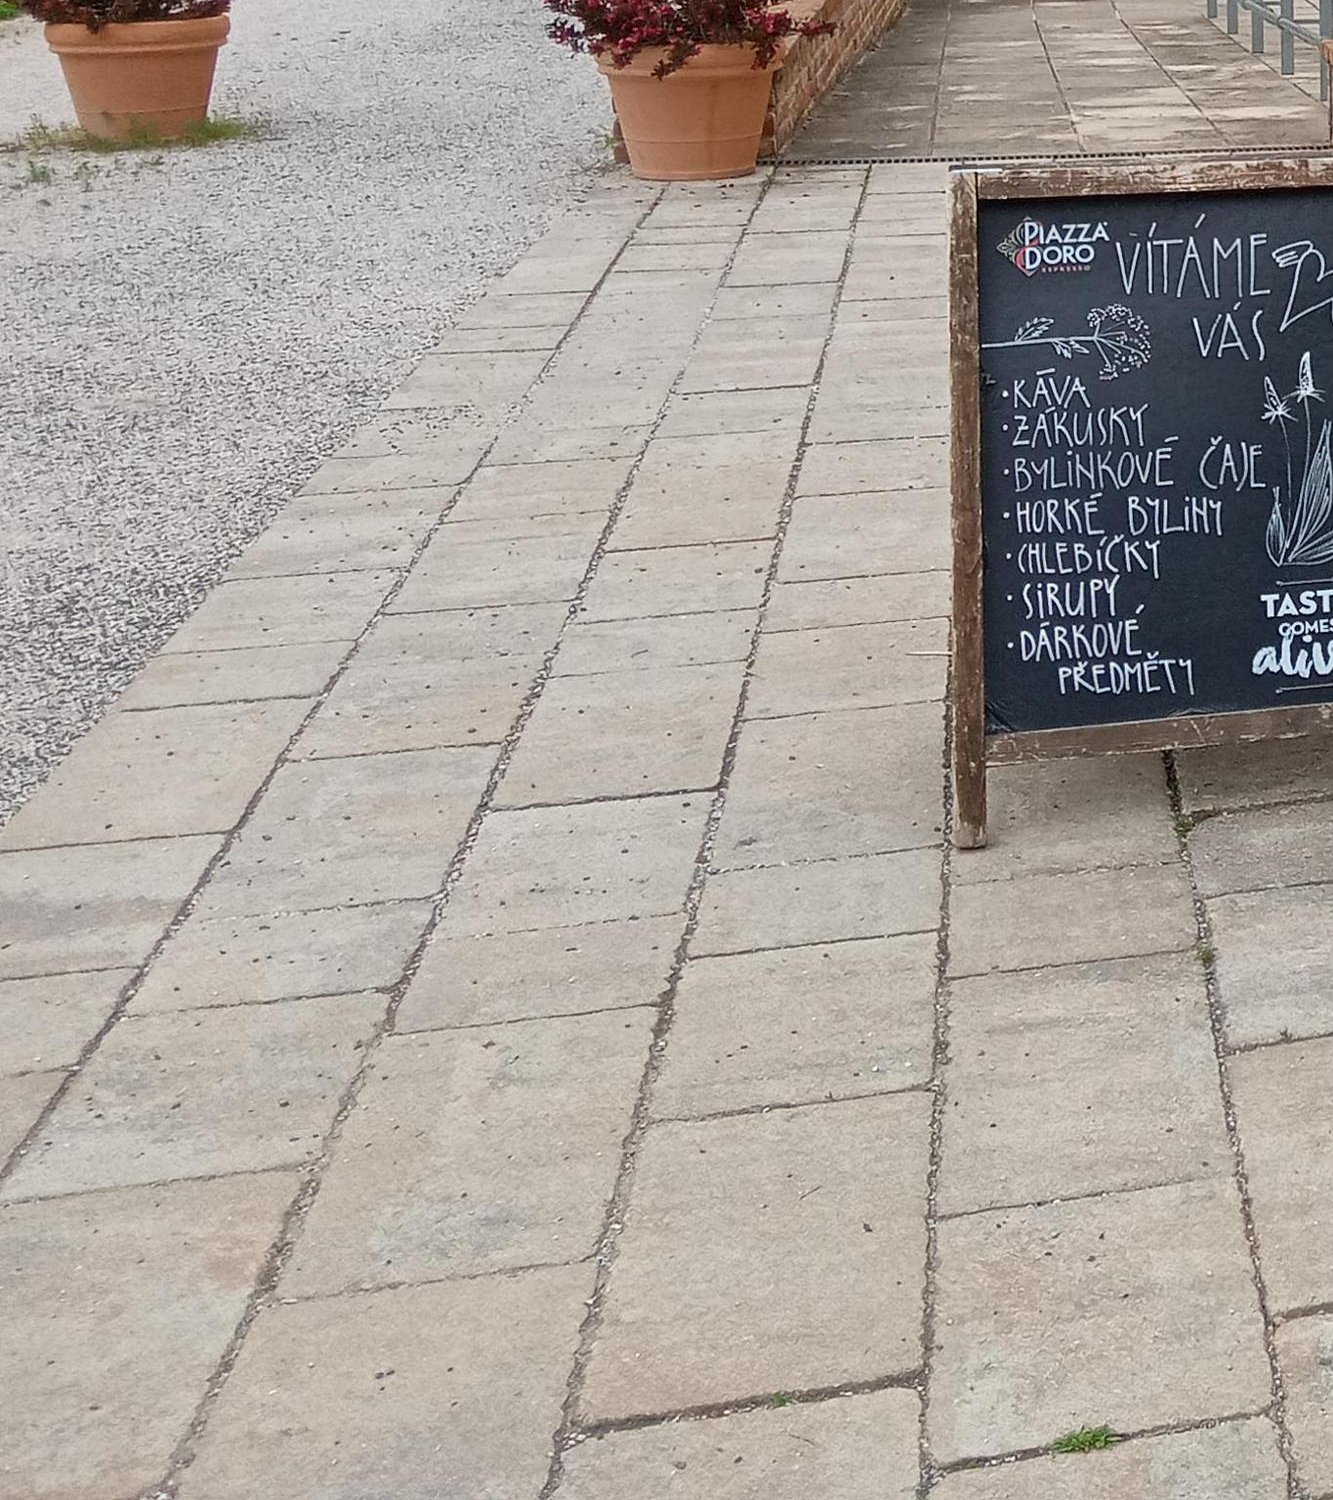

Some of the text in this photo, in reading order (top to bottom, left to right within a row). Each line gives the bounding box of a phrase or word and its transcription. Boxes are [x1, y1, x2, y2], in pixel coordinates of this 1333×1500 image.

[1024, 221, 1110, 246] PIAZZA
[1116, 213, 1271, 299] VÍTÁME
[1041, 264, 1091, 273] ESPRESSO
[1192, 301, 1266, 361] VÁS
[1013, 368, 1091, 409] KÁVA
[1012, 403, 1149, 448] ZÁKUSKY
[1199, 435, 1267, 492] ČAJE
[1016, 492, 1105, 535] HORKÉ
[1017, 534, 1161, 579] CHLEBÍČKY
[1019, 604, 1145, 662] DÁRKOVÉ
[1057, 650, 1196, 696] PŘEDMĚTY
